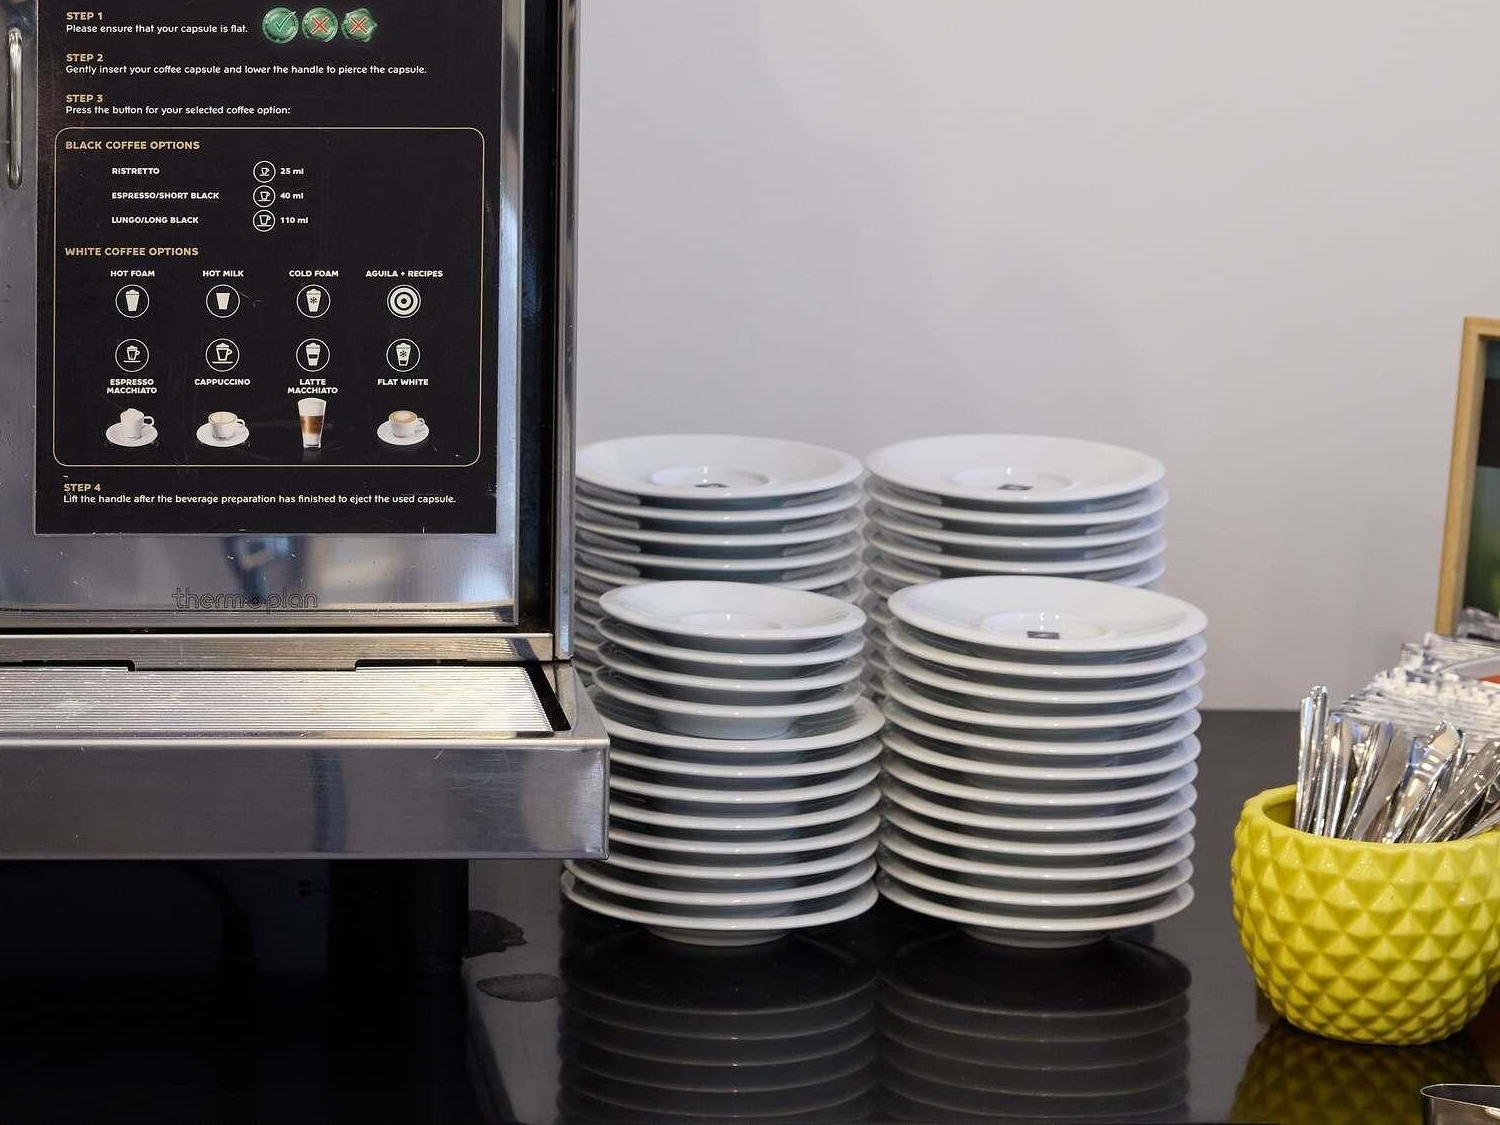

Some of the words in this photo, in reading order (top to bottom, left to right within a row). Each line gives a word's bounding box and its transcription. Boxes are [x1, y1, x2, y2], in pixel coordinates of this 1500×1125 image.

[66, 11, 95, 21] STEP
[97, 11, 103, 21] 1
[66, 24, 98, 33] Please
[99, 26, 133, 34] ensure
[135, 24, 155, 33] that
[156, 25, 180, 35] your
[180, 24, 218, 35] capsule
[220, 24, 229, 33] is
[230, 24, 248, 35] flat.
[65, 53, 95, 63] STEP
[96, 53, 104, 63] 2
[65, 64, 98, 76] Gently
[99, 64, 128, 74] insert
[129, 66, 152, 76] your
[153, 64, 182, 74] coffee
[184, 65, 222, 76] capsule
[223, 65, 243, 74] and
[244, 65, 272, 74] lower
[272, 64, 289, 74] the
[290, 65, 324, 74] handle
[326, 65, 337, 74] to
[337, 65, 368, 76] pierce
[369, 65, 386, 74] the
[387, 65, 427, 76] capsule.
[65, 93, 94, 103] STEP
[96, 94, 104, 103] 3
[65, 105, 92, 115] Press
[93, 105, 110, 115] the
[112, 105, 143, 115] button
[145, 105, 160, 115] for
[160, 107, 184, 116] your
[184, 105, 224, 115] selected
[226, 105, 255, 115] coffee
[256, 105, 291, 116] option:
[65, 140, 103, 150] BLACK
[105, 140, 147, 150] COFFEE
[149, 139, 201, 150] OPTIONS
[111, 167, 160, 175] RISTRETTO
[279, 167, 292, 175] 25
[292, 167, 305, 175] ml
[111, 191, 189, 200] ESPRESSO/SHORT
[190, 191, 220, 200] BLACK
[279, 191, 291, 200] 40
[292, 192, 304, 200] ml
[111, 216, 169, 224] LUNGO/LONG
[169, 216, 199, 224] BLACK
[279, 216, 295, 224] 110
[296, 216, 309, 224] ml
[64, 247, 102, 256] WHITE
[104, 246, 146, 257] COFFEE
[148, 247, 199, 257] OPTIONS
[110, 269, 130, 278] HOT
[130, 269, 156, 278] FOAM
[202, 269, 222, 278] HOT
[222, 269, 245, 278] MILK
[288, 269, 313, 278] COLD
[313, 269, 339, 278] FOAM
[365, 268, 399, 278] AGUILA
[407, 269, 444, 278] RECIPES
[109, 378, 155, 386] ESPRESSO
[194, 378, 251, 386] CAPPUCCINO
[299, 378, 327, 386] LATTE
[377, 378, 399, 386] FLAT
[400, 378, 429, 386] WHITE
[106, 386, 158, 395] MACCHIATO
[287, 386, 339, 395] MACCHIATO
[63, 483, 92, 492] STEP
[93, 483, 102, 492] 4
[63, 494, 79, 504] Lift
[80, 494, 96, 503] the
[98, 494, 132, 504] handle
[133, 494, 156, 503] after
[156, 494, 173, 504] the
[175, 494, 219, 506] beverage
[220, 494, 277, 505] preparation
[278, 494, 297, 504] has
[297, 494, 336, 504] finished
[337, 494, 348, 503] to
[349, 494, 373, 505] eject
[373, 494, 391, 504] the
[391, 494, 416, 504] used
[417, 494, 457, 507] capsule.
